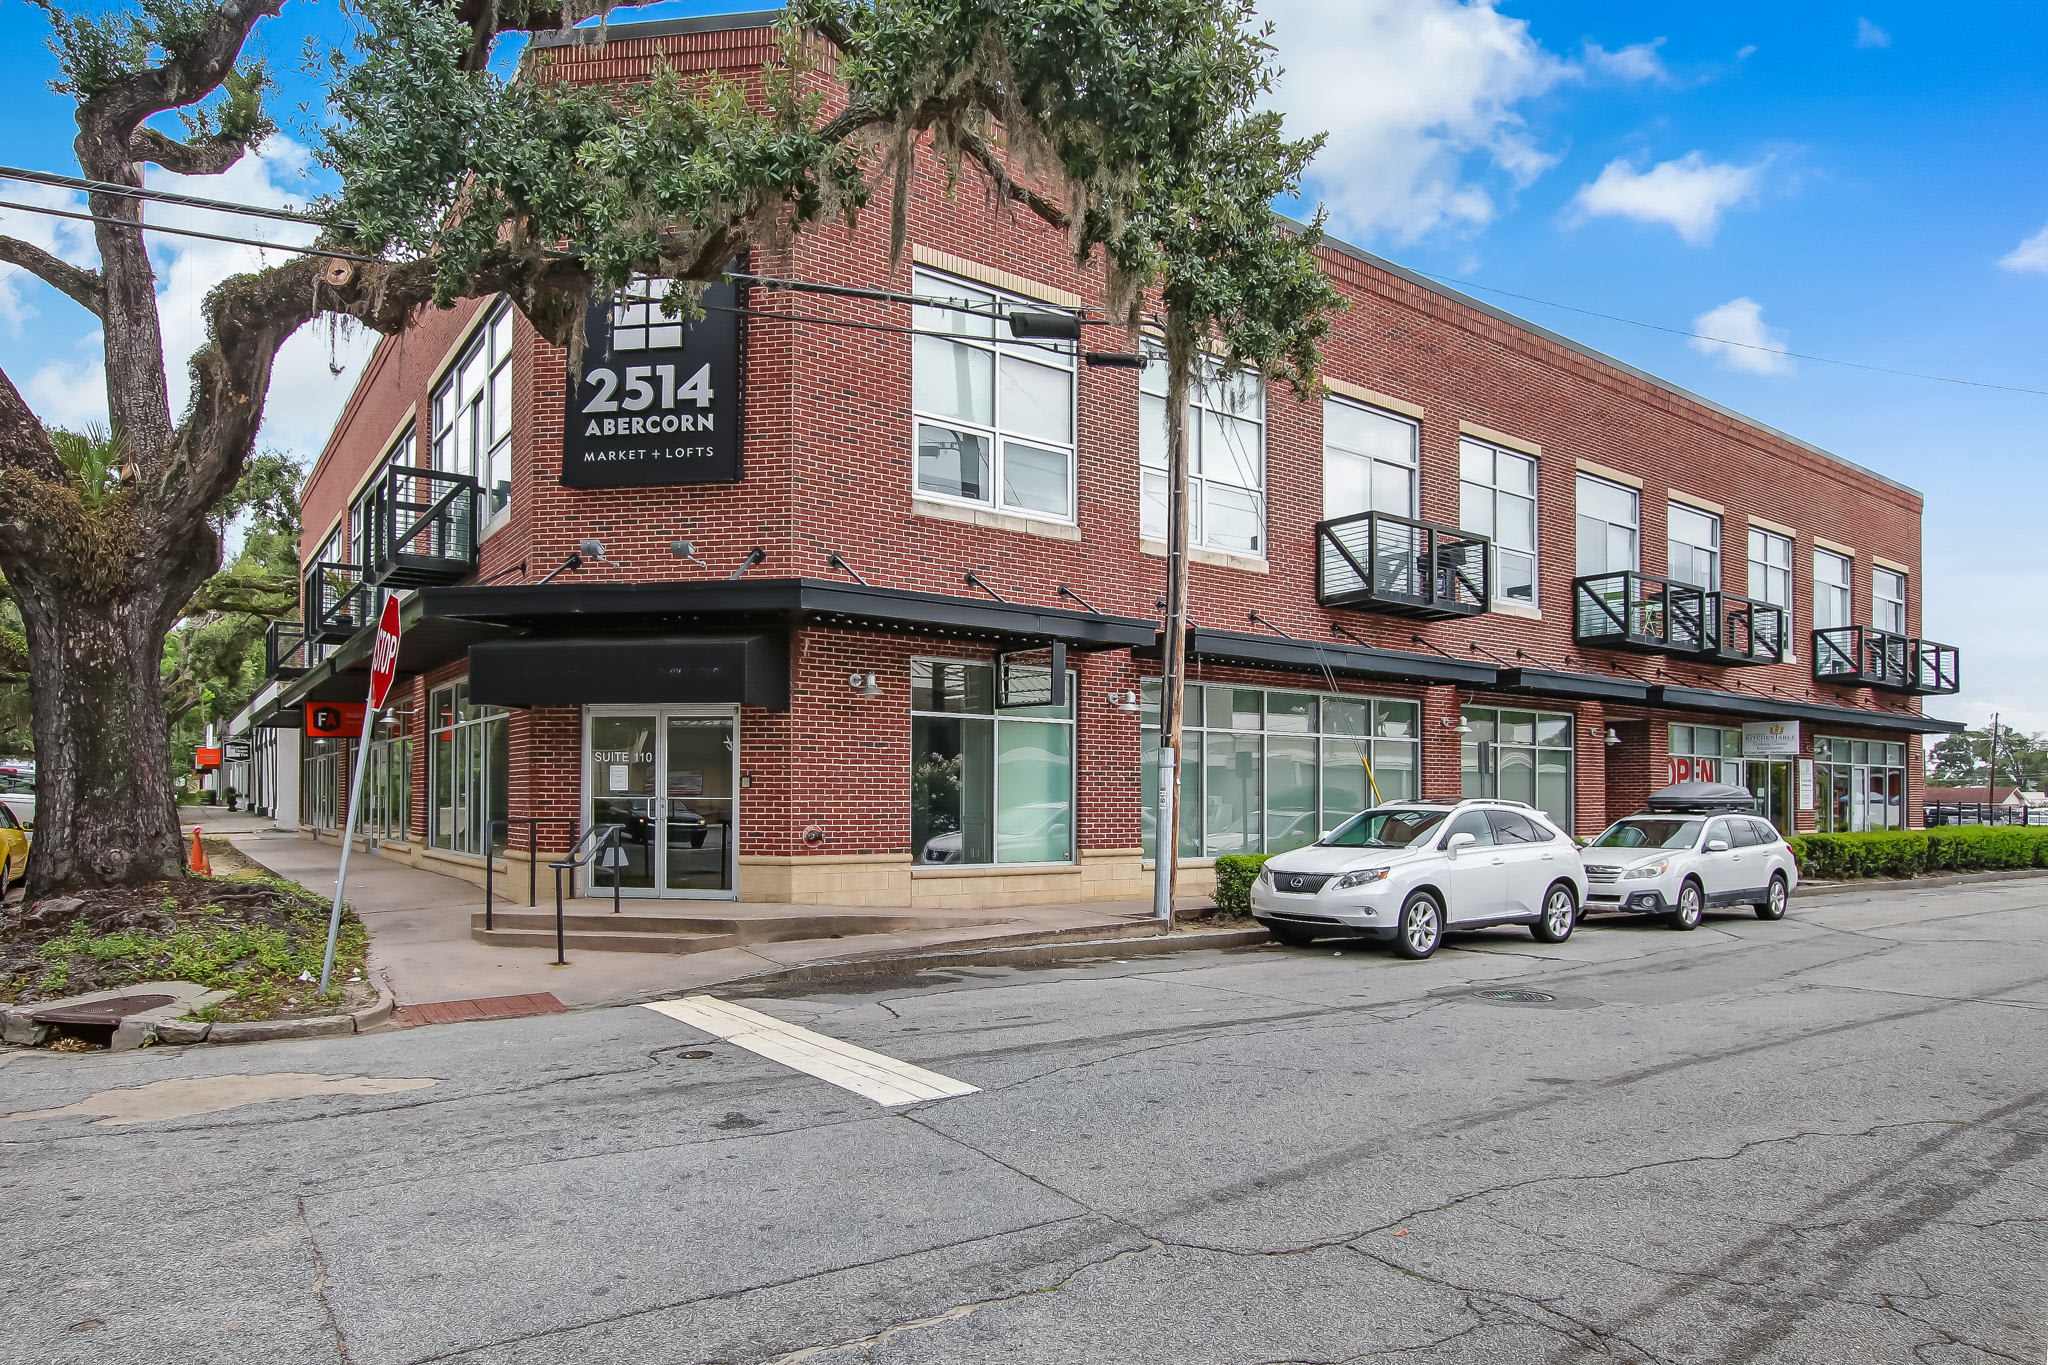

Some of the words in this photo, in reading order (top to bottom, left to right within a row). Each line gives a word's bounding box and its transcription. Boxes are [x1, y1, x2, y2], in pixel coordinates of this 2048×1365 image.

[581, 362, 715, 413] 2514
[584, 413, 714, 437] ABERCORN
[583, 449, 647, 462] MARKET
[666, 446, 714, 459] LOFTS
[373, 628, 398, 675] STOP
[318, 711, 337, 727] FA
[594, 751, 630, 763] SUITE
[633, 752, 653, 763] 110
